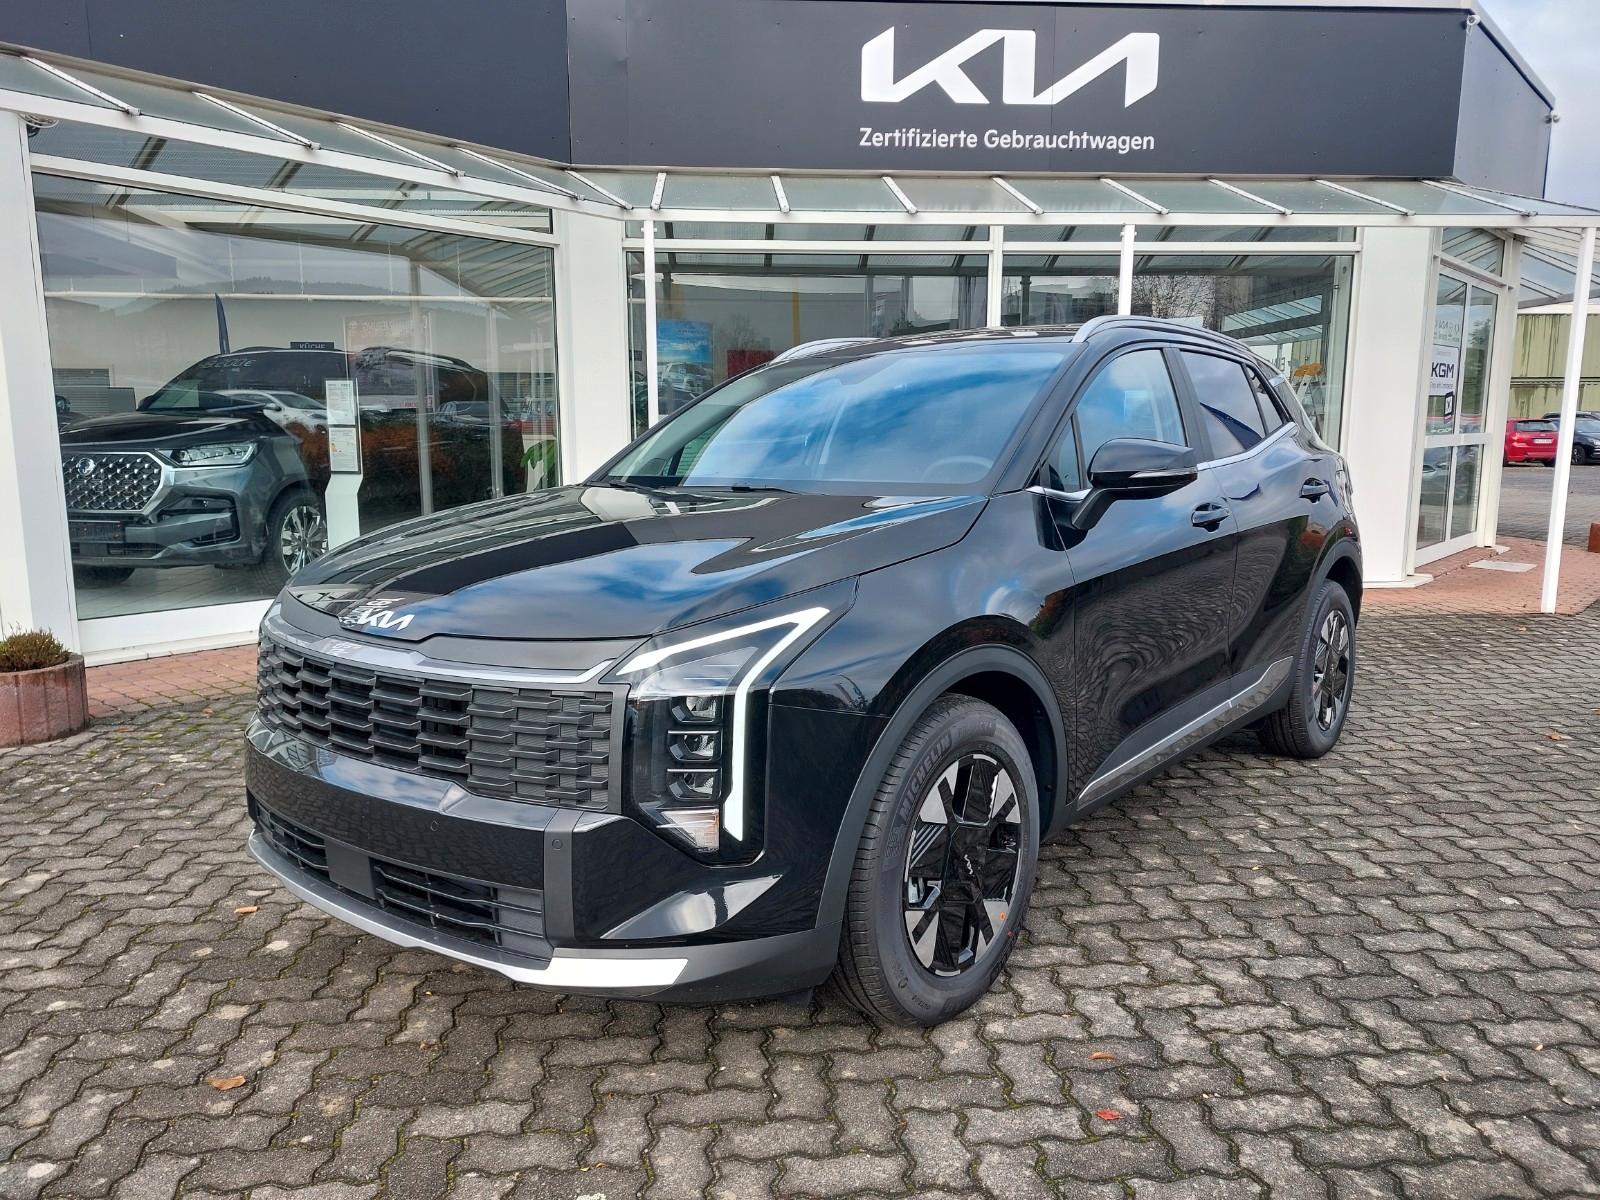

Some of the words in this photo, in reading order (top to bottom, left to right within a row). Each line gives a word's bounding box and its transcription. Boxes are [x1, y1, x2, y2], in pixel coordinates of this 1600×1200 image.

[861, 26, 1160, 108] KIA
[859, 127, 978, 149] Zertifizierte
[984, 129, 1155, 154] Gebrauchtwagen
[1431, 361, 1454, 379] KGM
[899, 730, 952, 820] MICHELIN
